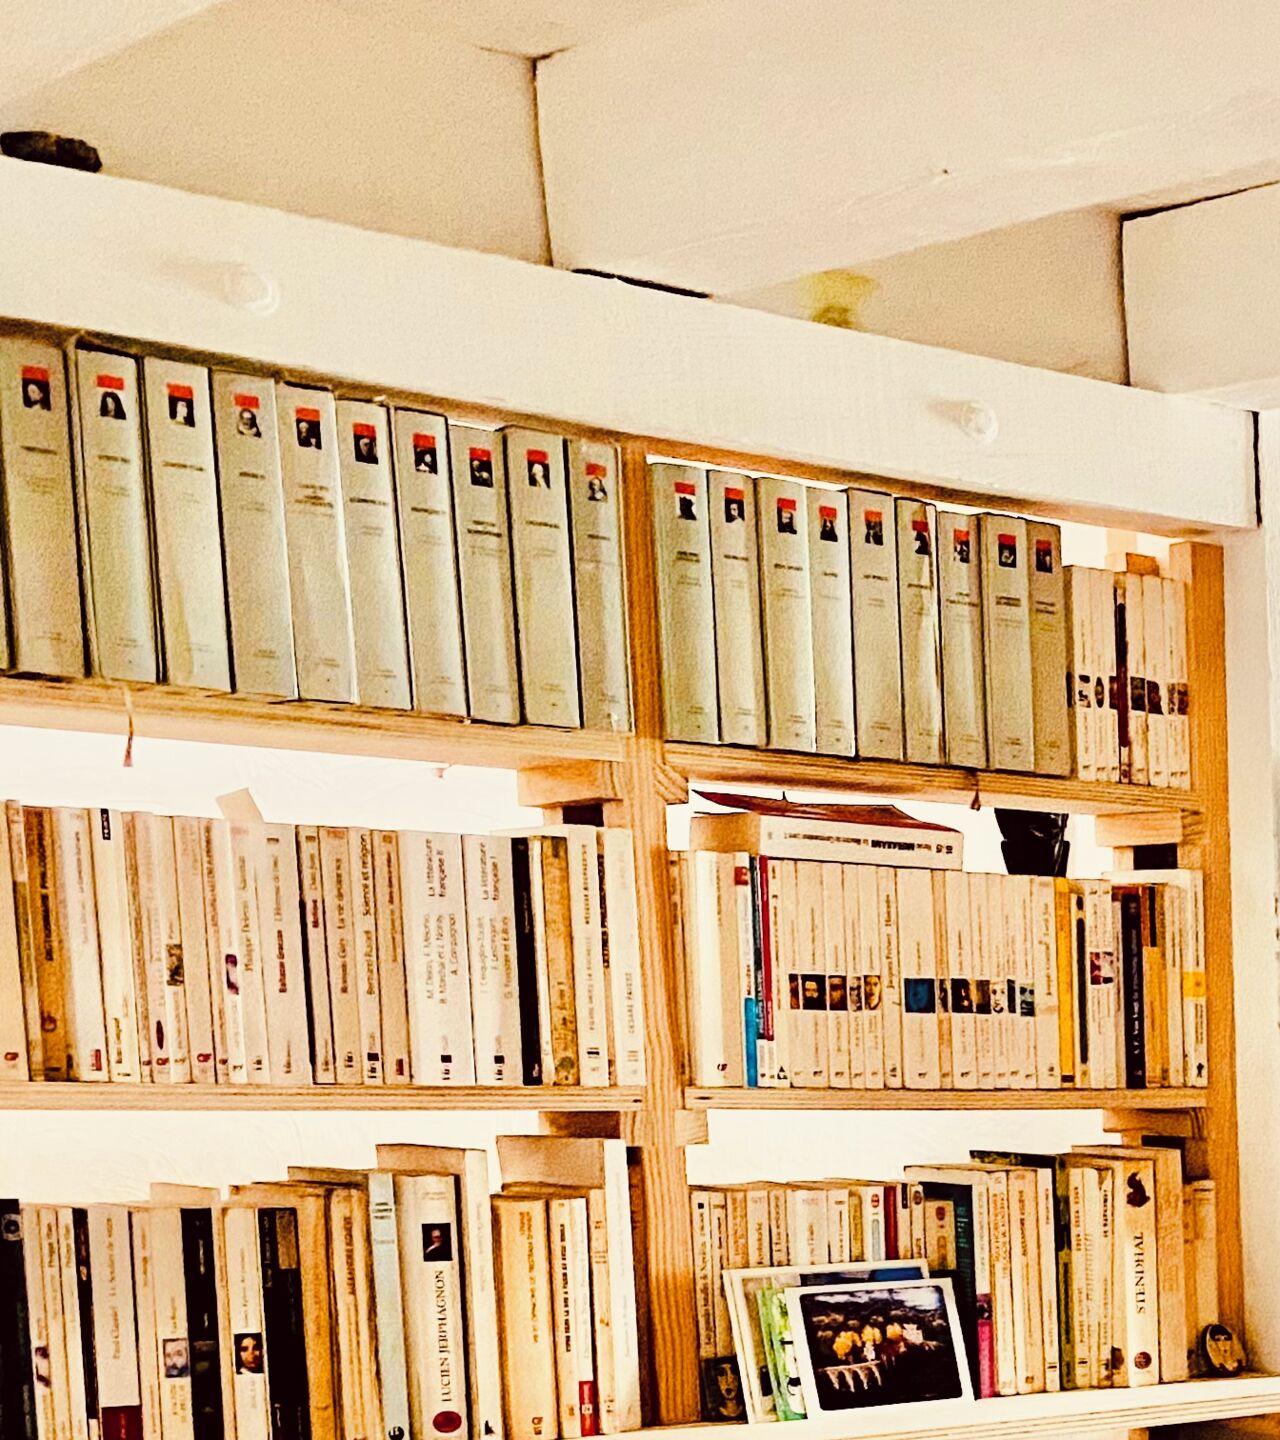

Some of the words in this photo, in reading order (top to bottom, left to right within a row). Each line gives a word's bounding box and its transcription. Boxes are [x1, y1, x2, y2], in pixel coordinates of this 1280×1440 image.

[434, 1269, 450, 1354] JERPHAGNON
[1134, 1232, 1146, 1314] STENDHAL
[438, 1356, 453, 1402] LUCIEN
